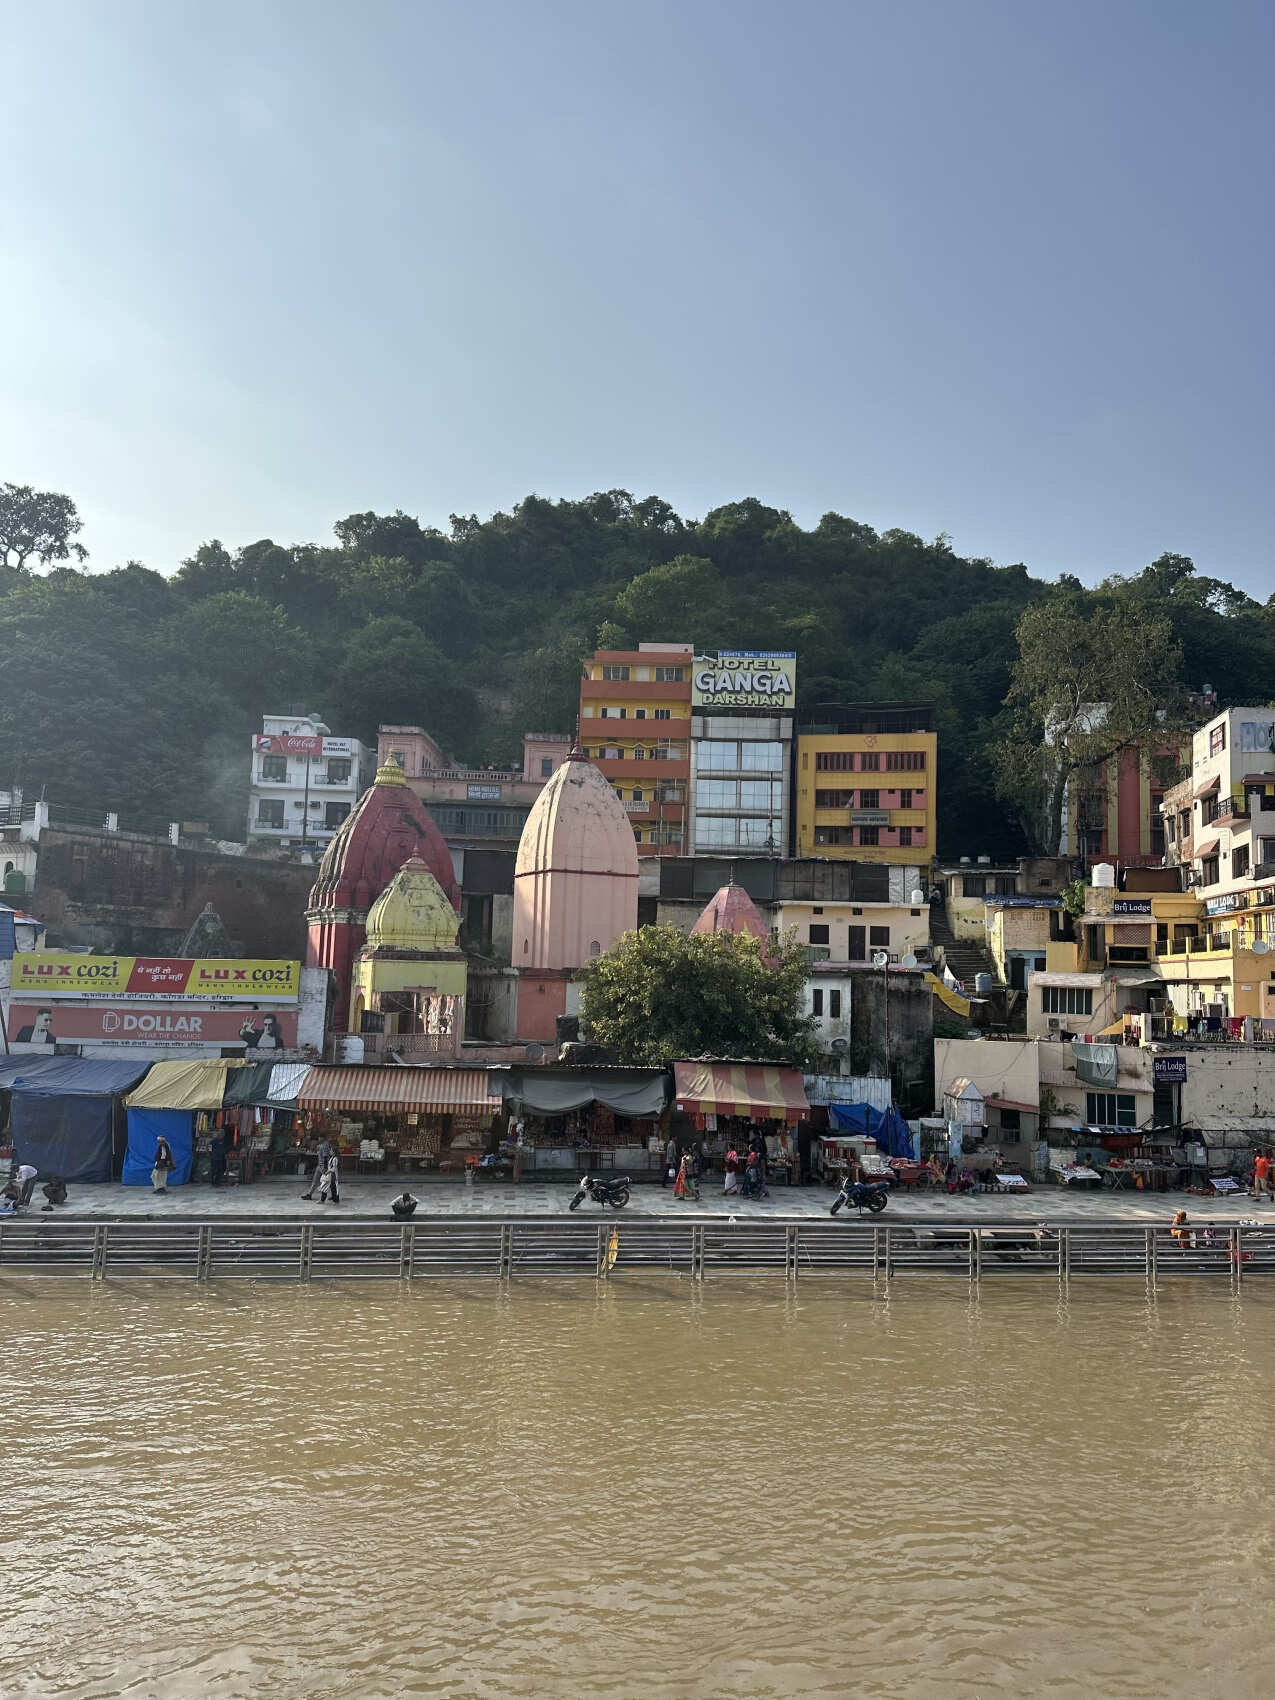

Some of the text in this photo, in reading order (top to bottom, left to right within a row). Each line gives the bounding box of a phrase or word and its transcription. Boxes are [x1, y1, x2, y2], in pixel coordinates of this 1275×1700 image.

[708, 659, 780, 671] HOTEL
[695, 670, 792, 695] GANGA
[702, 693, 784, 707] DARSHAN
[1114, 900, 1151, 913] Brij Lodge
[22, 960, 119, 979] LUX cozi
[200, 964, 292, 982] LUX cozi
[123, 1014, 202, 1033] DOLLAR
[1167, 1061, 1186, 1072] Lodge
